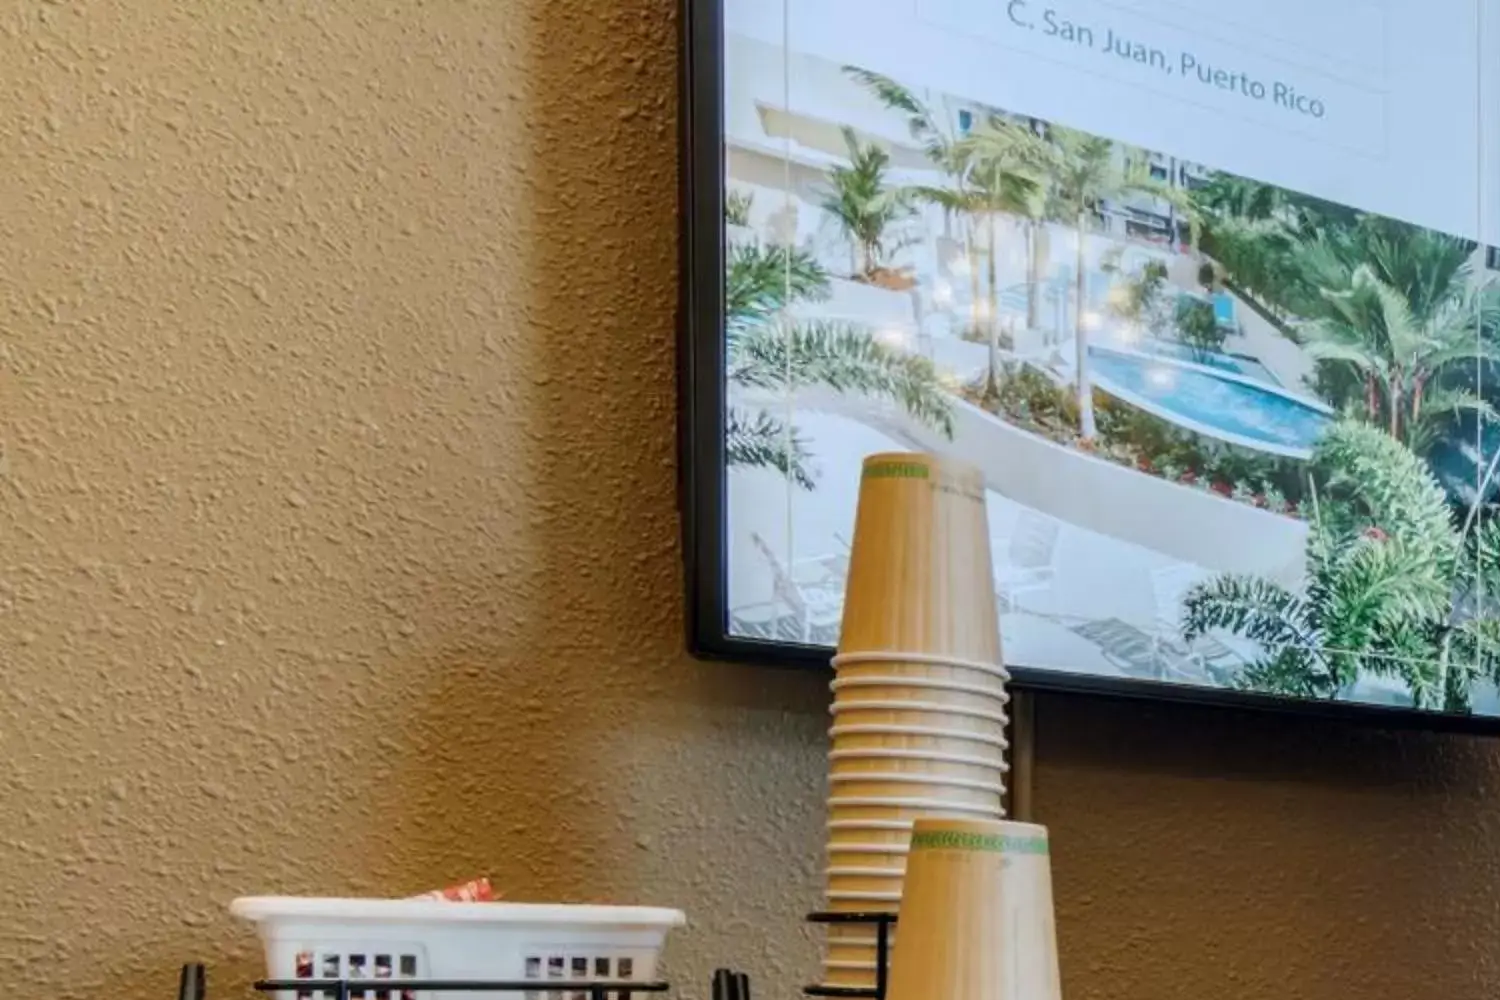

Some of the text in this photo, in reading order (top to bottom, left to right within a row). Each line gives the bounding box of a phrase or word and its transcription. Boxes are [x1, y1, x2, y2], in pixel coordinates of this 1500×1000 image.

[1007, 0, 1325, 118] C. San Juan, Puerto Rico
